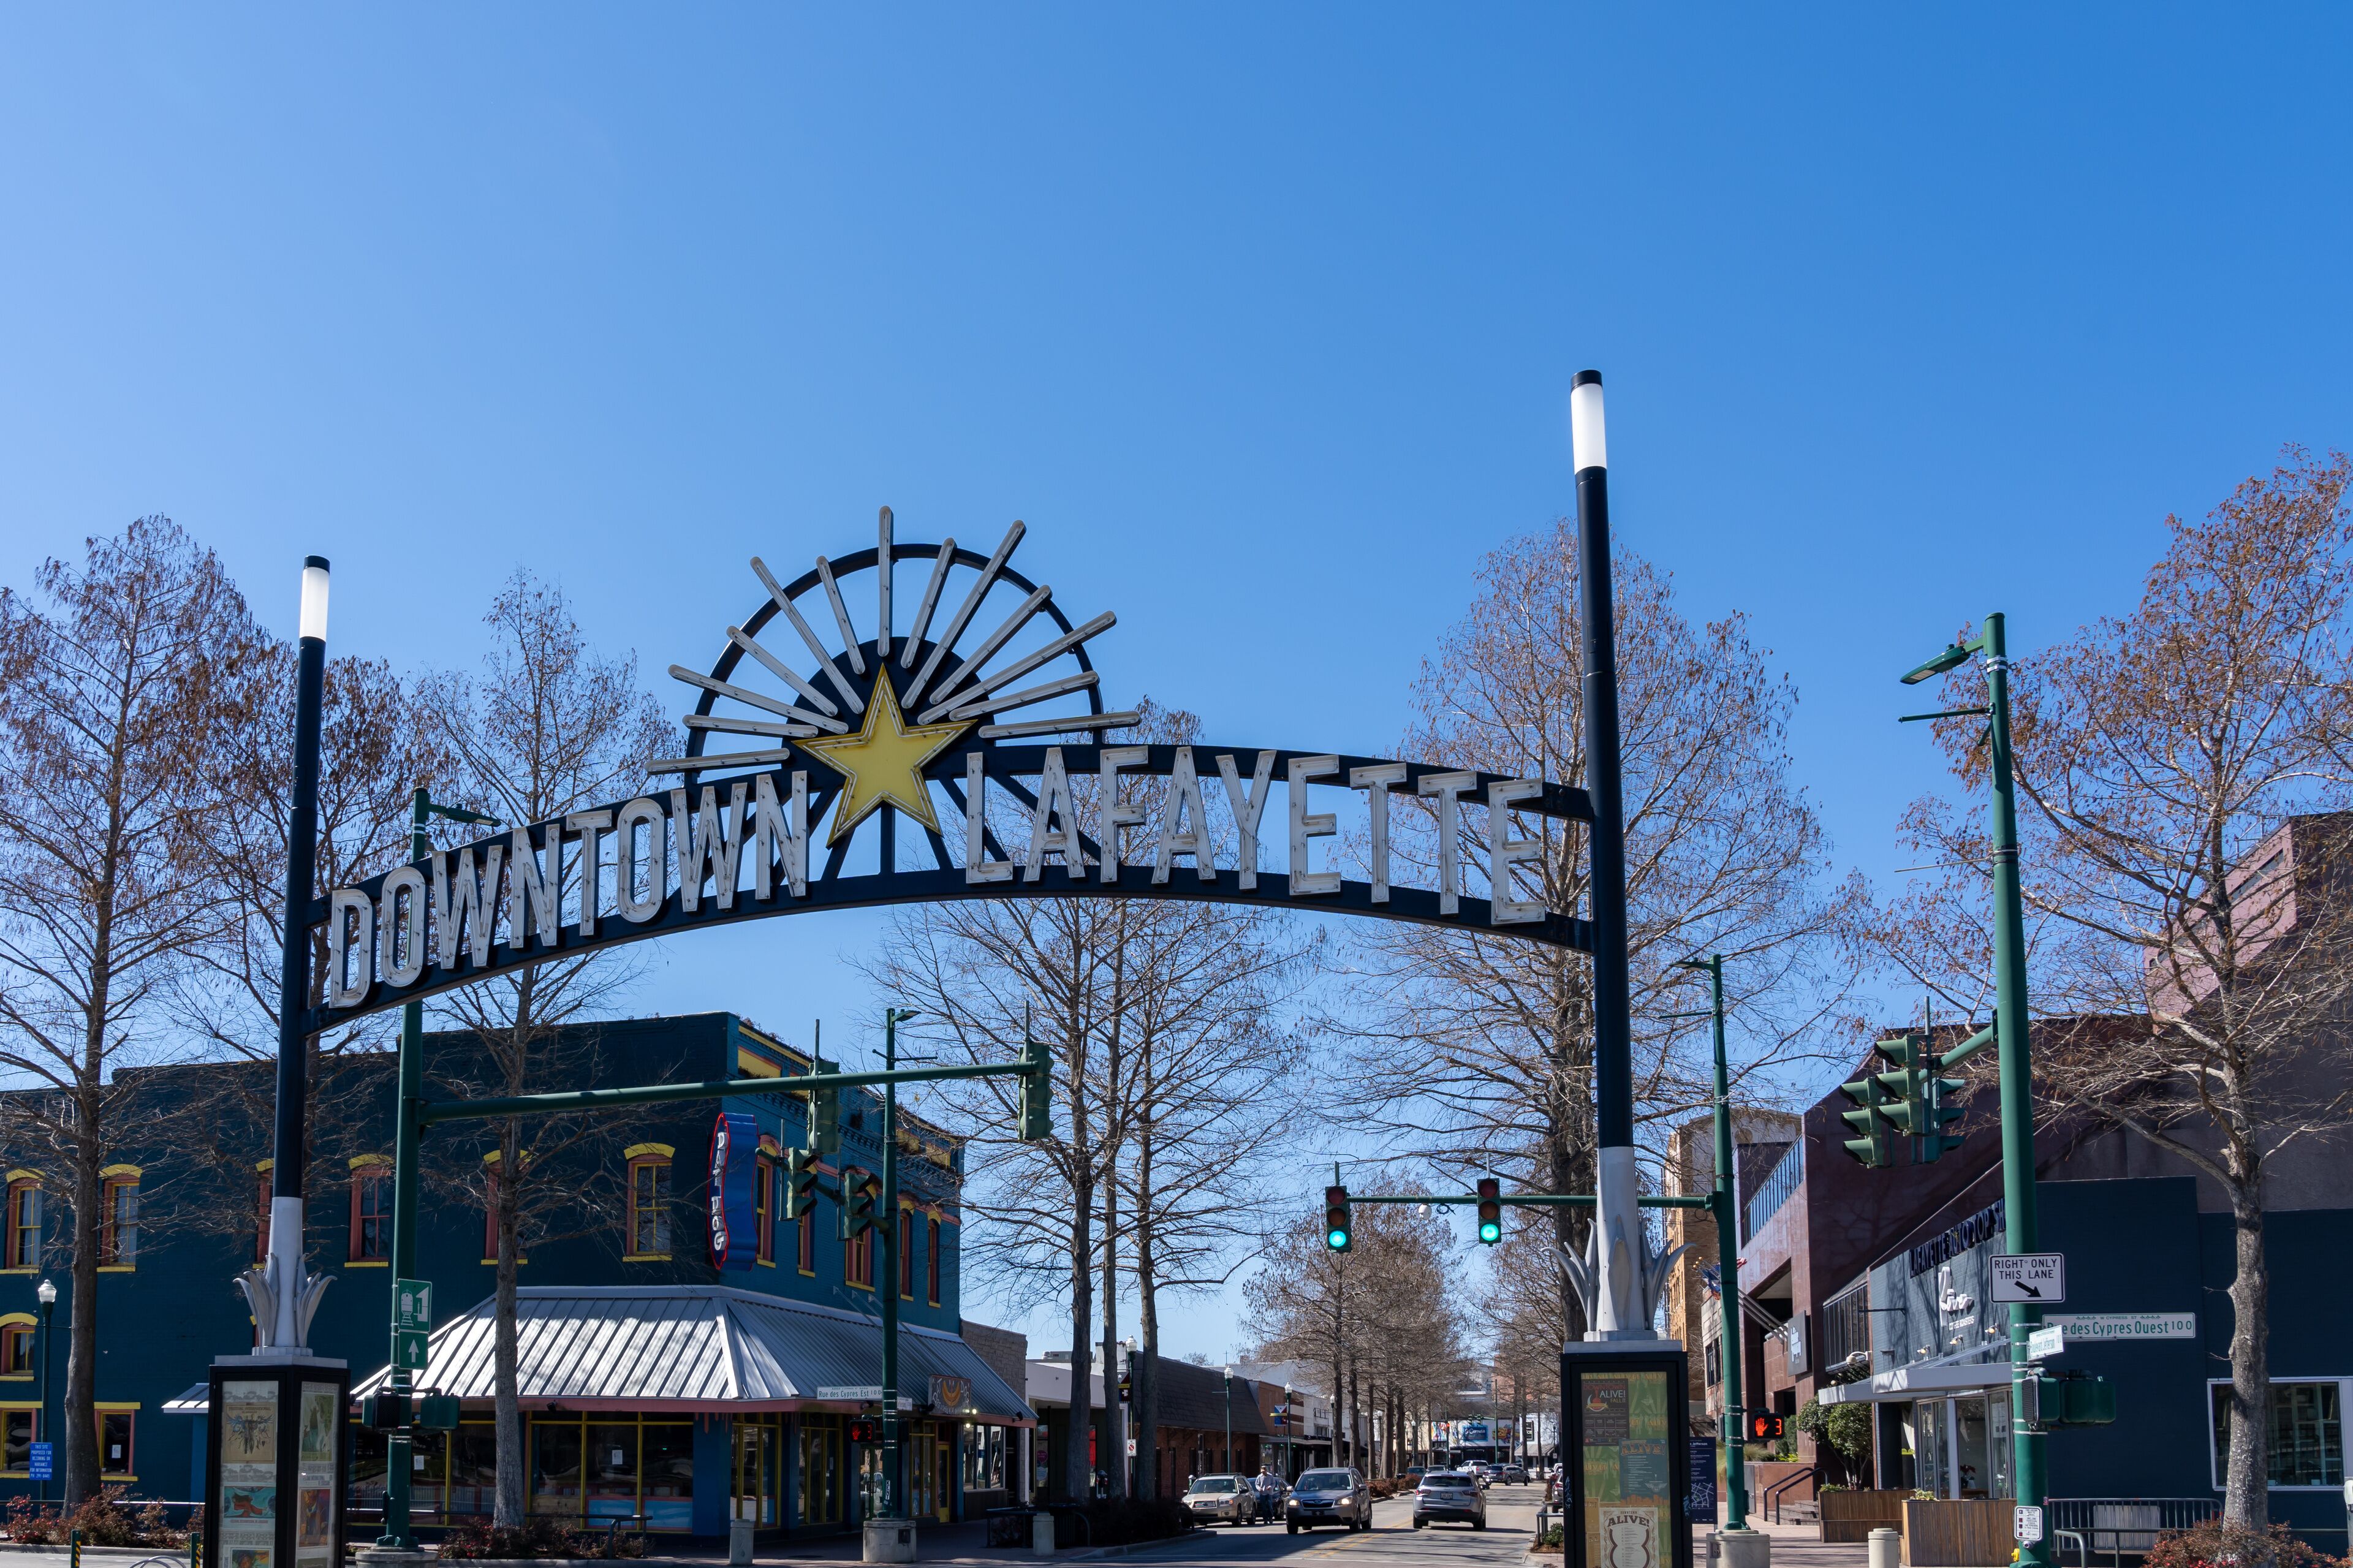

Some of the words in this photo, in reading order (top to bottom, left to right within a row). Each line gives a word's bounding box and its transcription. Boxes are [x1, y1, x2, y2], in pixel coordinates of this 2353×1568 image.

[328, 770, 809, 1009] DOWNTOWN
[965, 745, 1546, 925] LAFAYETTE
[1909, 1233, 1947, 1278] LAFAYETTE
[1949, 1221, 1971, 1257] AUTO
[1994, 1259, 2023, 1269] RIGHT
[2031, 1259, 2058, 1268] ONLY
[1999, 1270, 2021, 1280] THIS
[2028, 1270, 2054, 1279] LANE
[2071, 1323, 2090, 1335] des
[2093, 1322, 2132, 1336] Cypres
[2135, 1320, 2169, 1334] Ouest
[2172, 1320, 2192, 1330] 100
[841, 1390, 858, 1398] Cypres
[1775, 1418, 1782, 1435] 3
[1621, 1444, 1666, 1456] ALIVE!
[1607, 1515, 1650, 1528] ALIVE!
